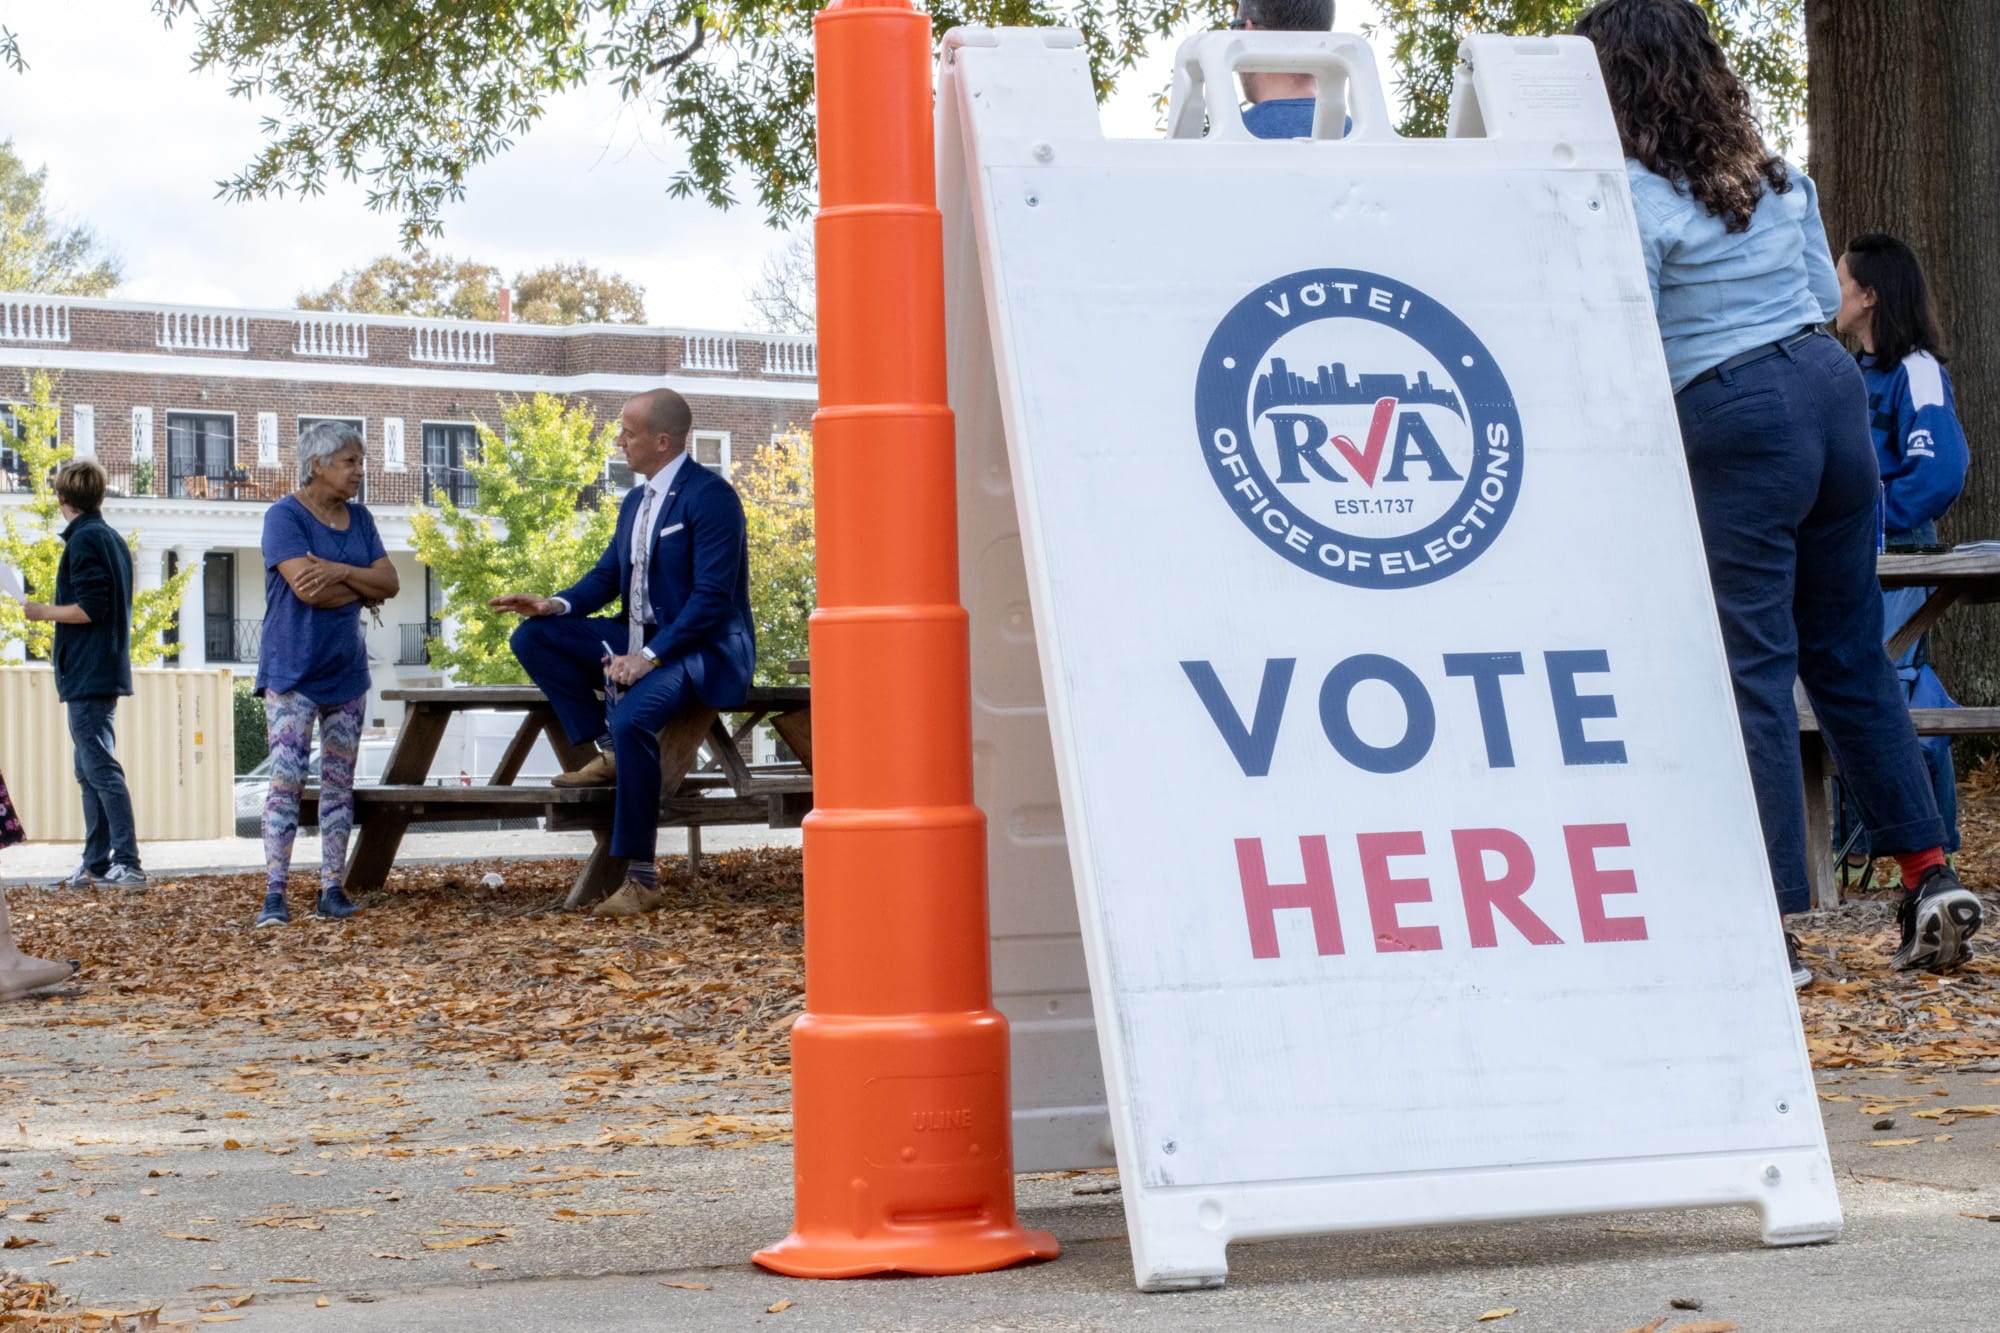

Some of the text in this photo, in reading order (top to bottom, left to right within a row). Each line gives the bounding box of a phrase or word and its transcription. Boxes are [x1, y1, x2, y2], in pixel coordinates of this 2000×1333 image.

[1265, 282, 1411, 320] VOTE!
[1214, 423, 1510, 575] OFFICE OF ELECTIONS
[1335, 499, 1414, 515] EST.1737
[1179, 649, 1628, 777] VOTE
[1234, 823, 1648, 959] HERE
[912, 1109, 972, 1131] ULINE
